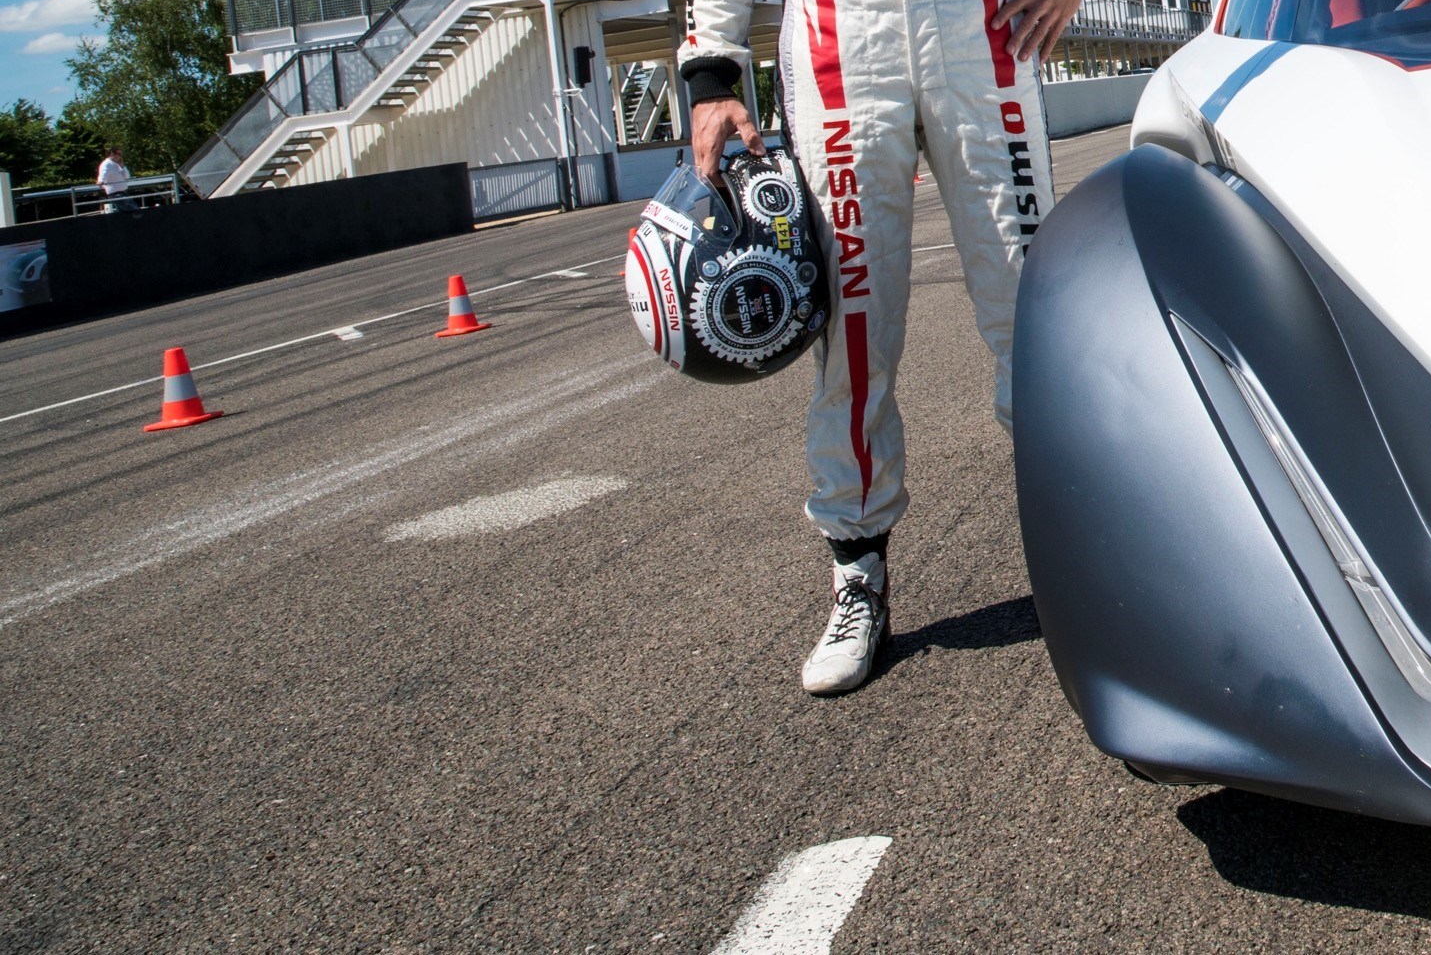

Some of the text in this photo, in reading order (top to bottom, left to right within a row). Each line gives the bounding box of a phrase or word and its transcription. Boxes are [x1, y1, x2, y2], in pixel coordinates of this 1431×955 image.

[1071, 27, 1081, 35] 10
[823, 120, 871, 300] NISSAN
[777, 222, 790, 245] 141
[631, 301, 649, 314] nis
[660, 268, 681, 332] NISSAN
[734, 285, 752, 335] NISSAN
[700, 305, 715, 340] ROUGE
